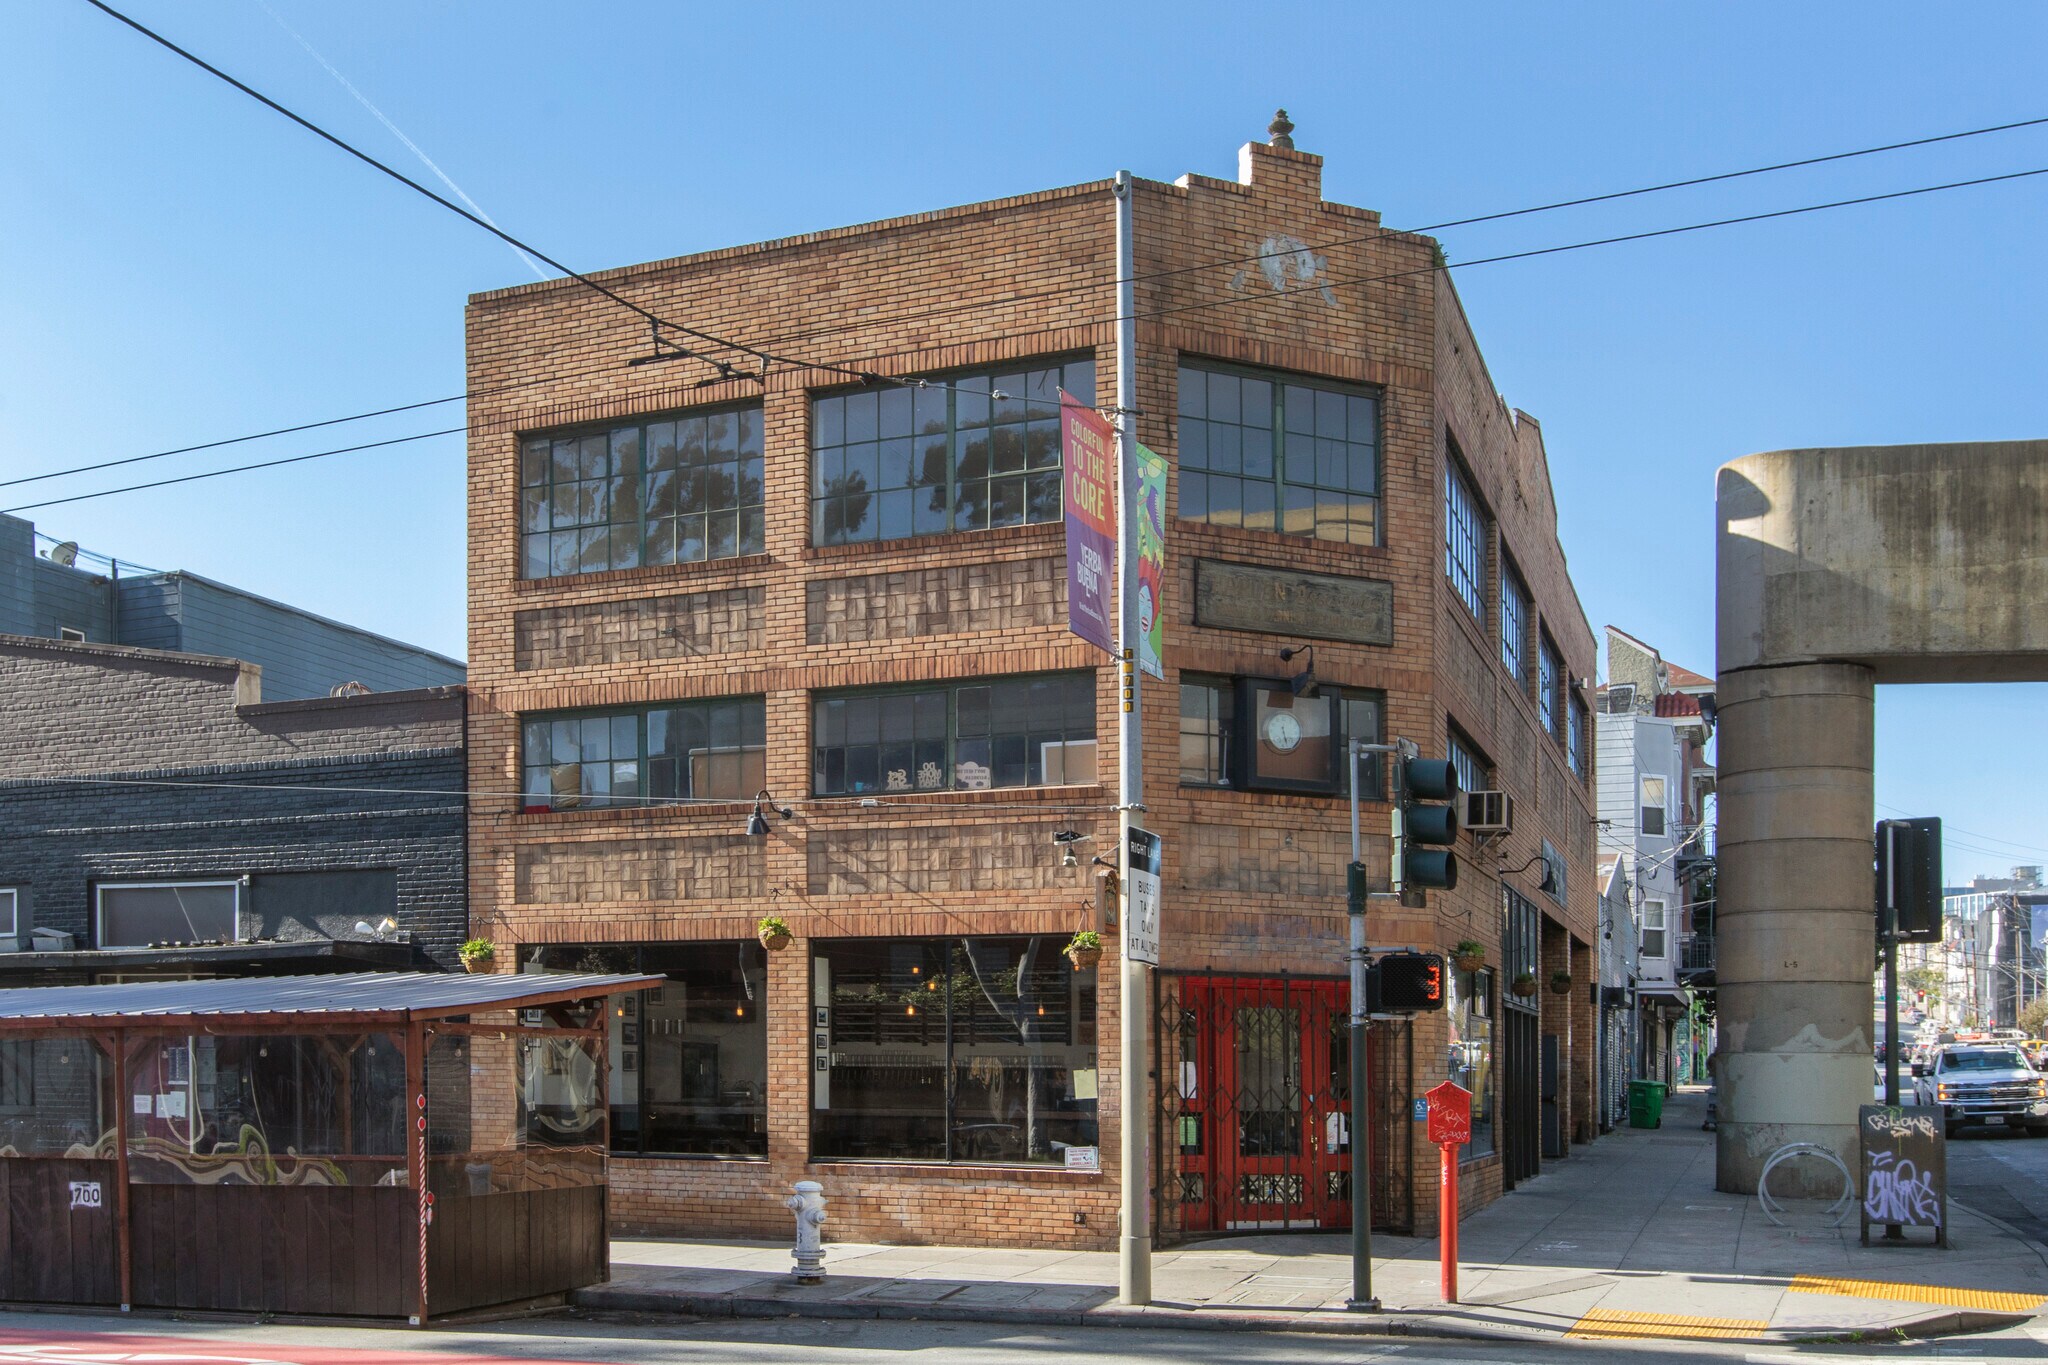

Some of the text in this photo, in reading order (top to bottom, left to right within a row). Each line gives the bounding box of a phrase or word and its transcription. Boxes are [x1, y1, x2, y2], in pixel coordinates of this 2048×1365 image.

[1070, 417, 1105, 456] COLORFUL
[1071, 439, 1105, 484] TO THE
[1073, 471, 1105, 521] CORE
[1080, 542, 1102, 576] YERBA
[1077, 560, 1098, 598] BUENA
[1130, 841, 1147, 856] RIGHT
[1138, 880, 1155, 897] BUSES
[1140, 900, 1155, 916] TAS
[1130, 937, 1139, 951] AT
[1427, 965, 1440, 1000] 3
[74, 1187, 100, 1203] 700
